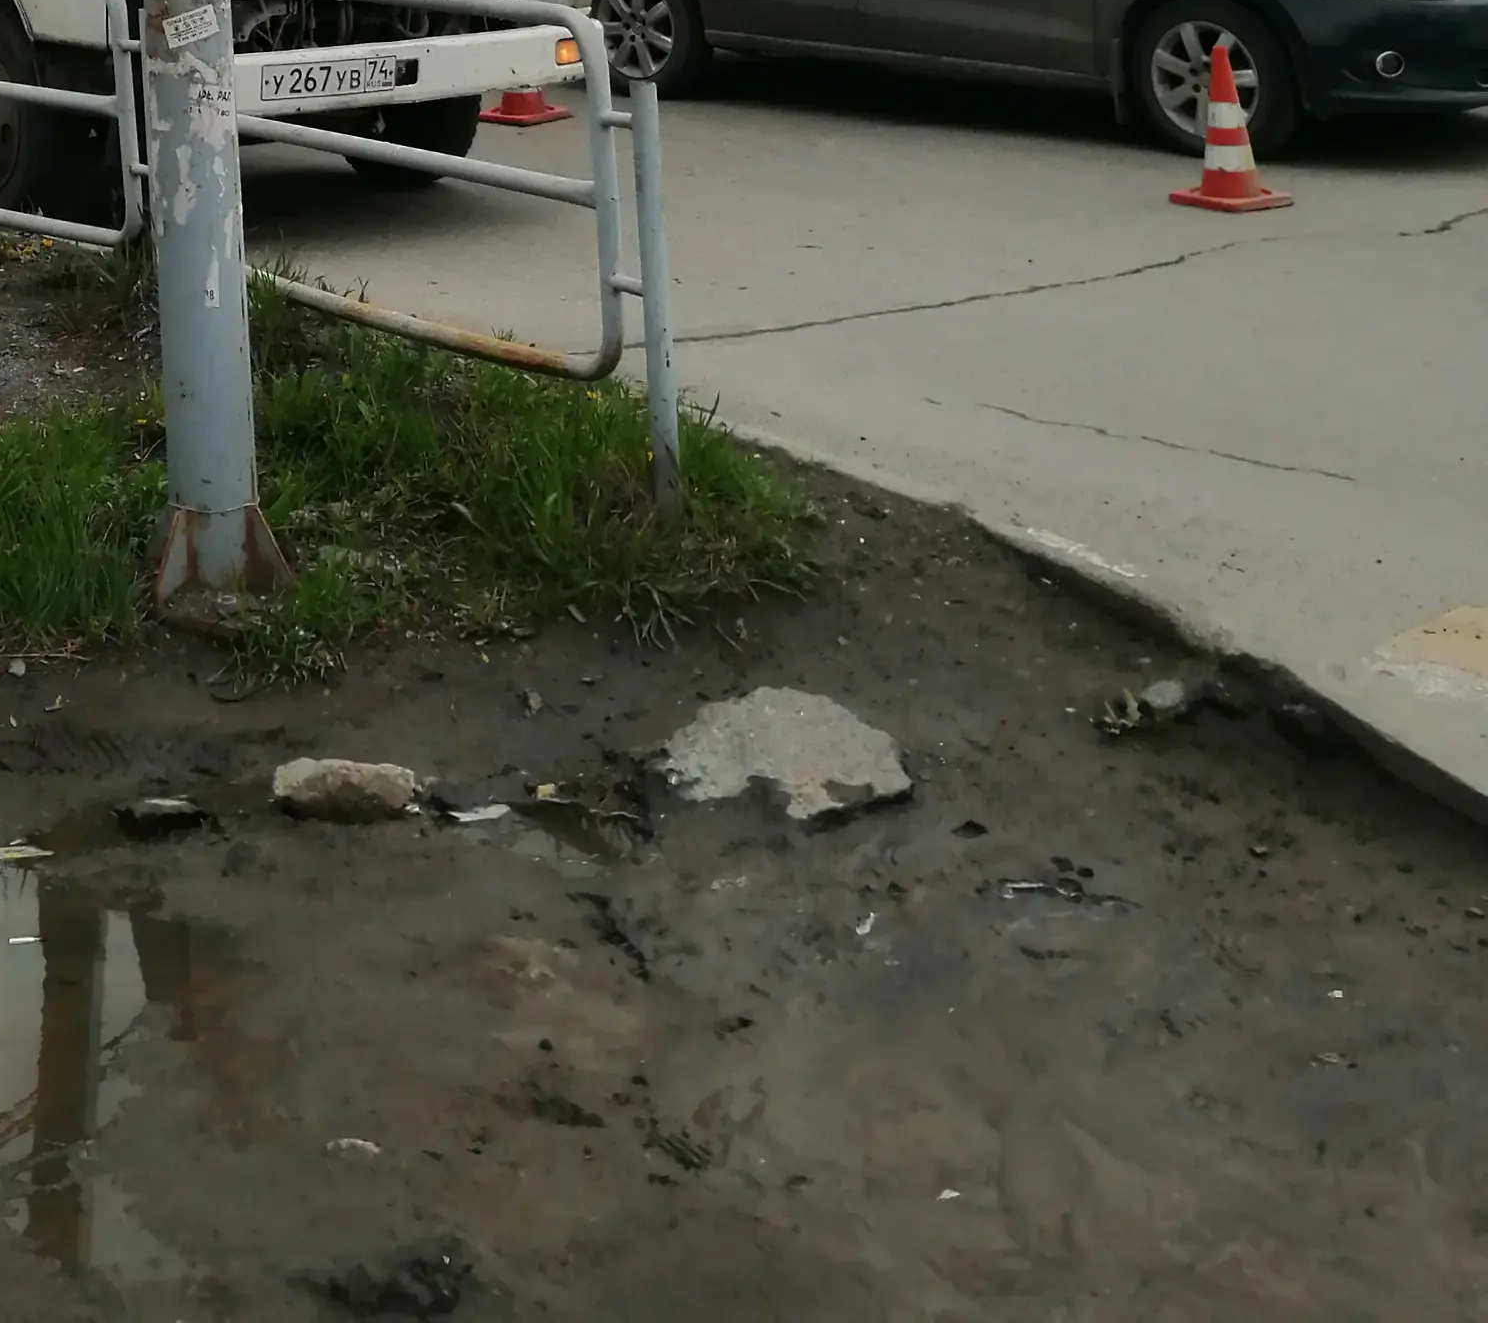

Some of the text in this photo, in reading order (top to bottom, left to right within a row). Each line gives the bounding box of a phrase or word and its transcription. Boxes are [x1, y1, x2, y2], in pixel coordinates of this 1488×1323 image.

[273, 59, 388, 95] У267УВ 74
[366, 77, 381, 87] RUS
